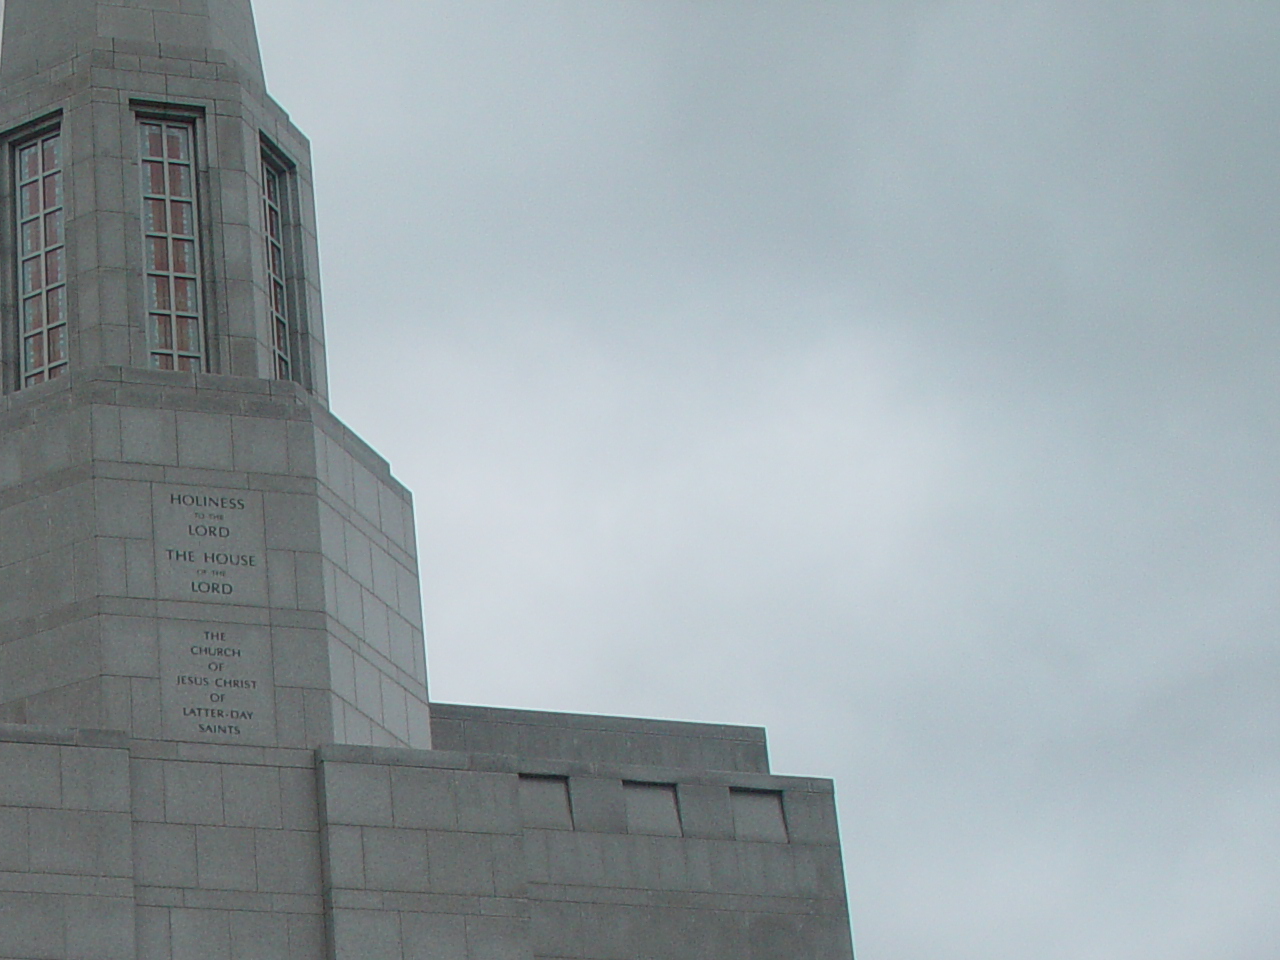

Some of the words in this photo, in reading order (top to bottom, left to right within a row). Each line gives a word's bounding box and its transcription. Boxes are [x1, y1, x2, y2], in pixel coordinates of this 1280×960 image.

[170, 493, 245, 510] HOLINESS
[188, 524, 230, 538] LORD
[166, 549, 195, 563] THE
[204, 552, 256, 567] HOUSE
[191, 581, 233, 595] LORD
[203, 631, 226, 642] THE
[190, 646, 241, 658] CHURCH
[208, 661, 225, 672] OF
[176, 675, 209, 687] JESUS
[214, 677, 257, 689] CHRIST
[209, 692, 225, 703] OF
[182, 707, 254, 720] LATTER-DAY
[198, 723, 241, 735] SAINTS
